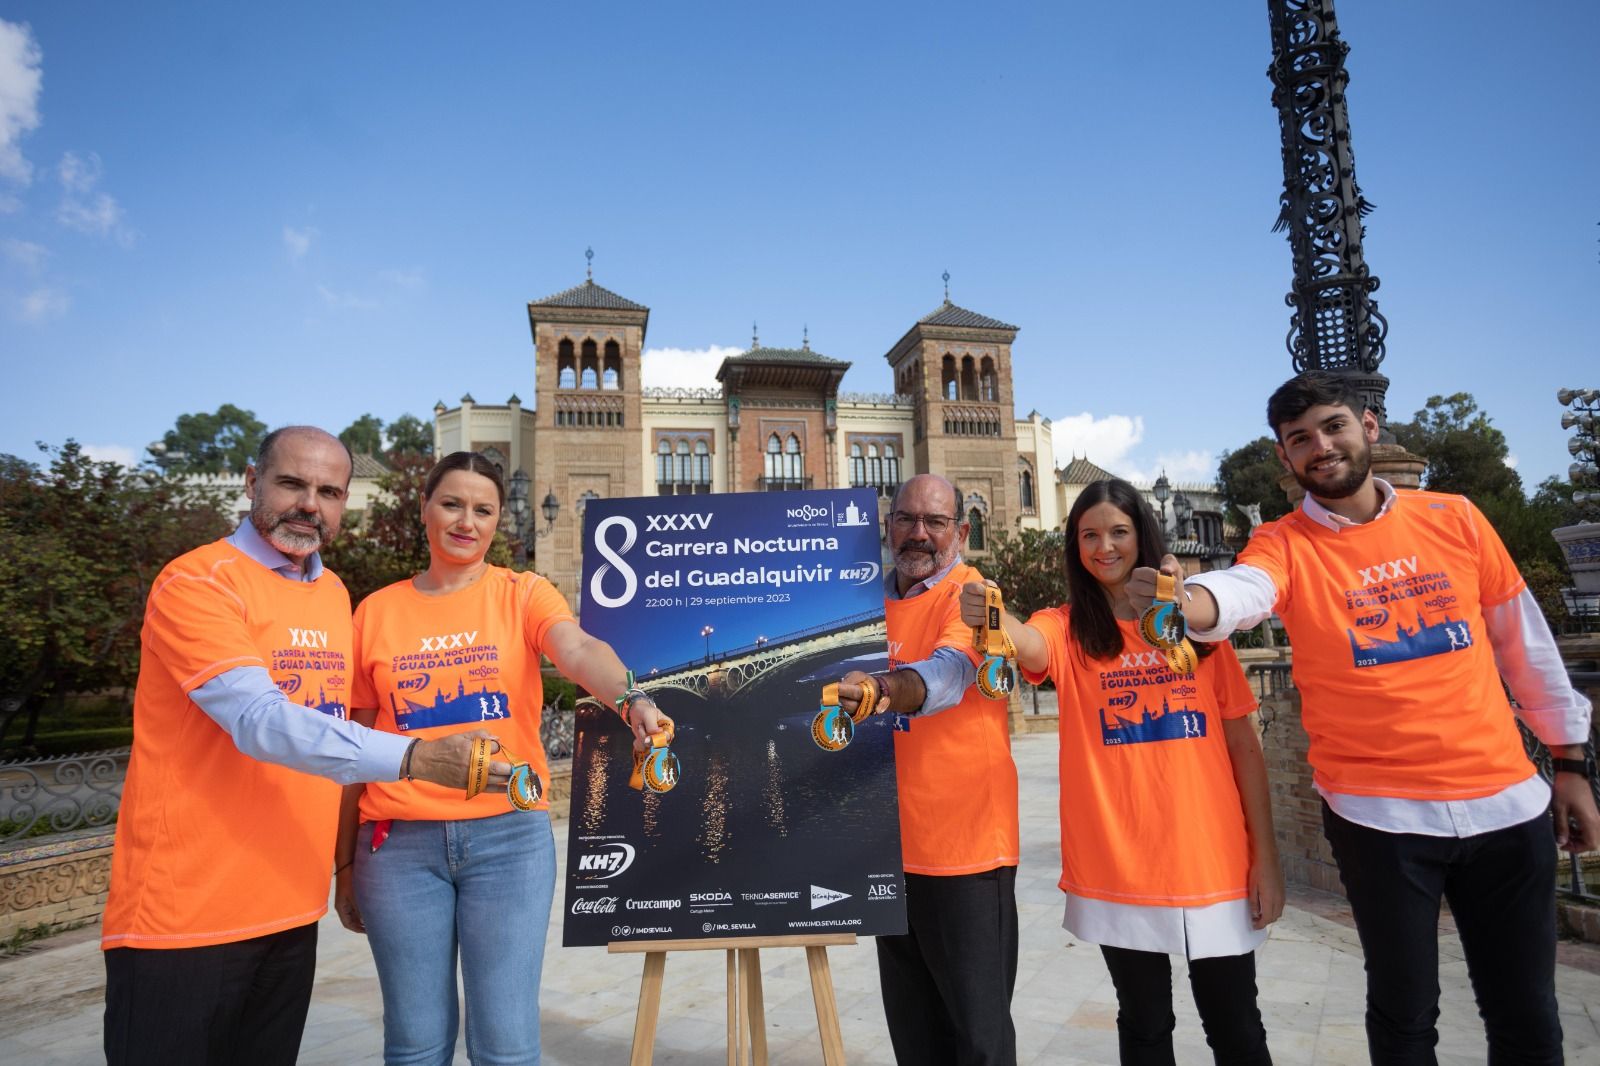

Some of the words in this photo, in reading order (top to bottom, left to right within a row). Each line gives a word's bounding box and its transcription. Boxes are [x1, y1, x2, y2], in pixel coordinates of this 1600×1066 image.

[645, 513, 713, 531] XXXV
[645, 540, 728, 557] Carrera
[734, 537, 839, 554] Nocturna
[645, 570, 680, 588] del
[687, 564, 832, 587] Guadalquivir
[1357, 555, 1417, 587] XXXV
[1391, 571, 1448, 589] NOCTURNA
[645, 598, 673, 608] 22:00
[675, 598, 682, 606] h
[690, 597, 702, 606] 29
[704, 594, 764, 607] septiembre
[766, 593, 791, 603] 2023
[1355, 579, 1452, 608] GUADALQUIVIR
[288, 627, 328, 649] XXXV
[419, 630, 479, 652] XXXV
[271, 649, 306, 658] CARRERA
[393, 653, 440, 662] CARRERA
[444, 645, 498, 657] NOCTURNA
[399, 652, 498, 671] GUADALQUIVIR
[279, 659, 346, 672] GUADAQUIVIR
[1100, 669, 1143, 679] CARRERA
[1145, 666, 1170, 676] NOCT
[868, 884, 897, 896] ABC
[625, 898, 682, 910] Cruzcampo
[788, 919, 862, 928] WWW.IMD.SEVILLA.ORG
